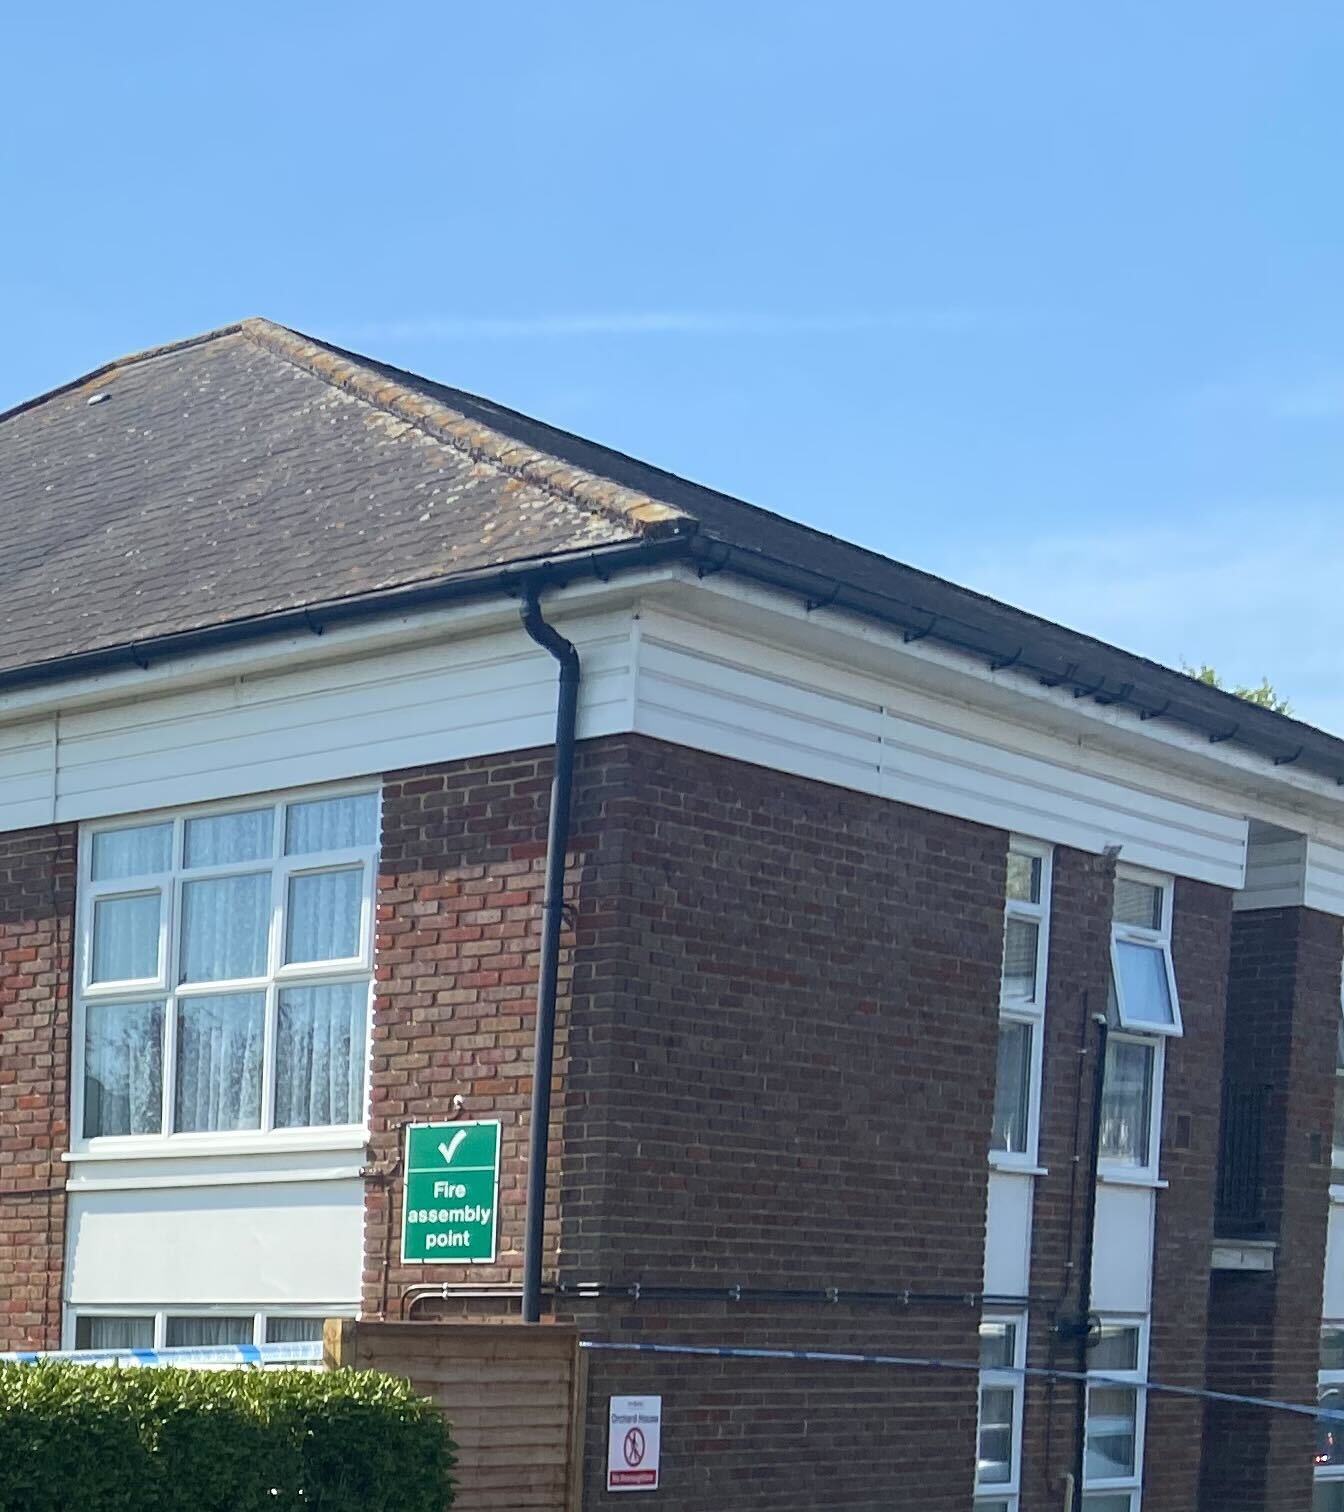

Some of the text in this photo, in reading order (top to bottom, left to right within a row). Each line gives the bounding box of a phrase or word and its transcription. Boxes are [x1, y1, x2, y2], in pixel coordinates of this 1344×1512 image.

[433, 1180, 467, 1199] Fire
[407, 1205, 491, 1226] assembly
[425, 1229, 471, 1250] point
